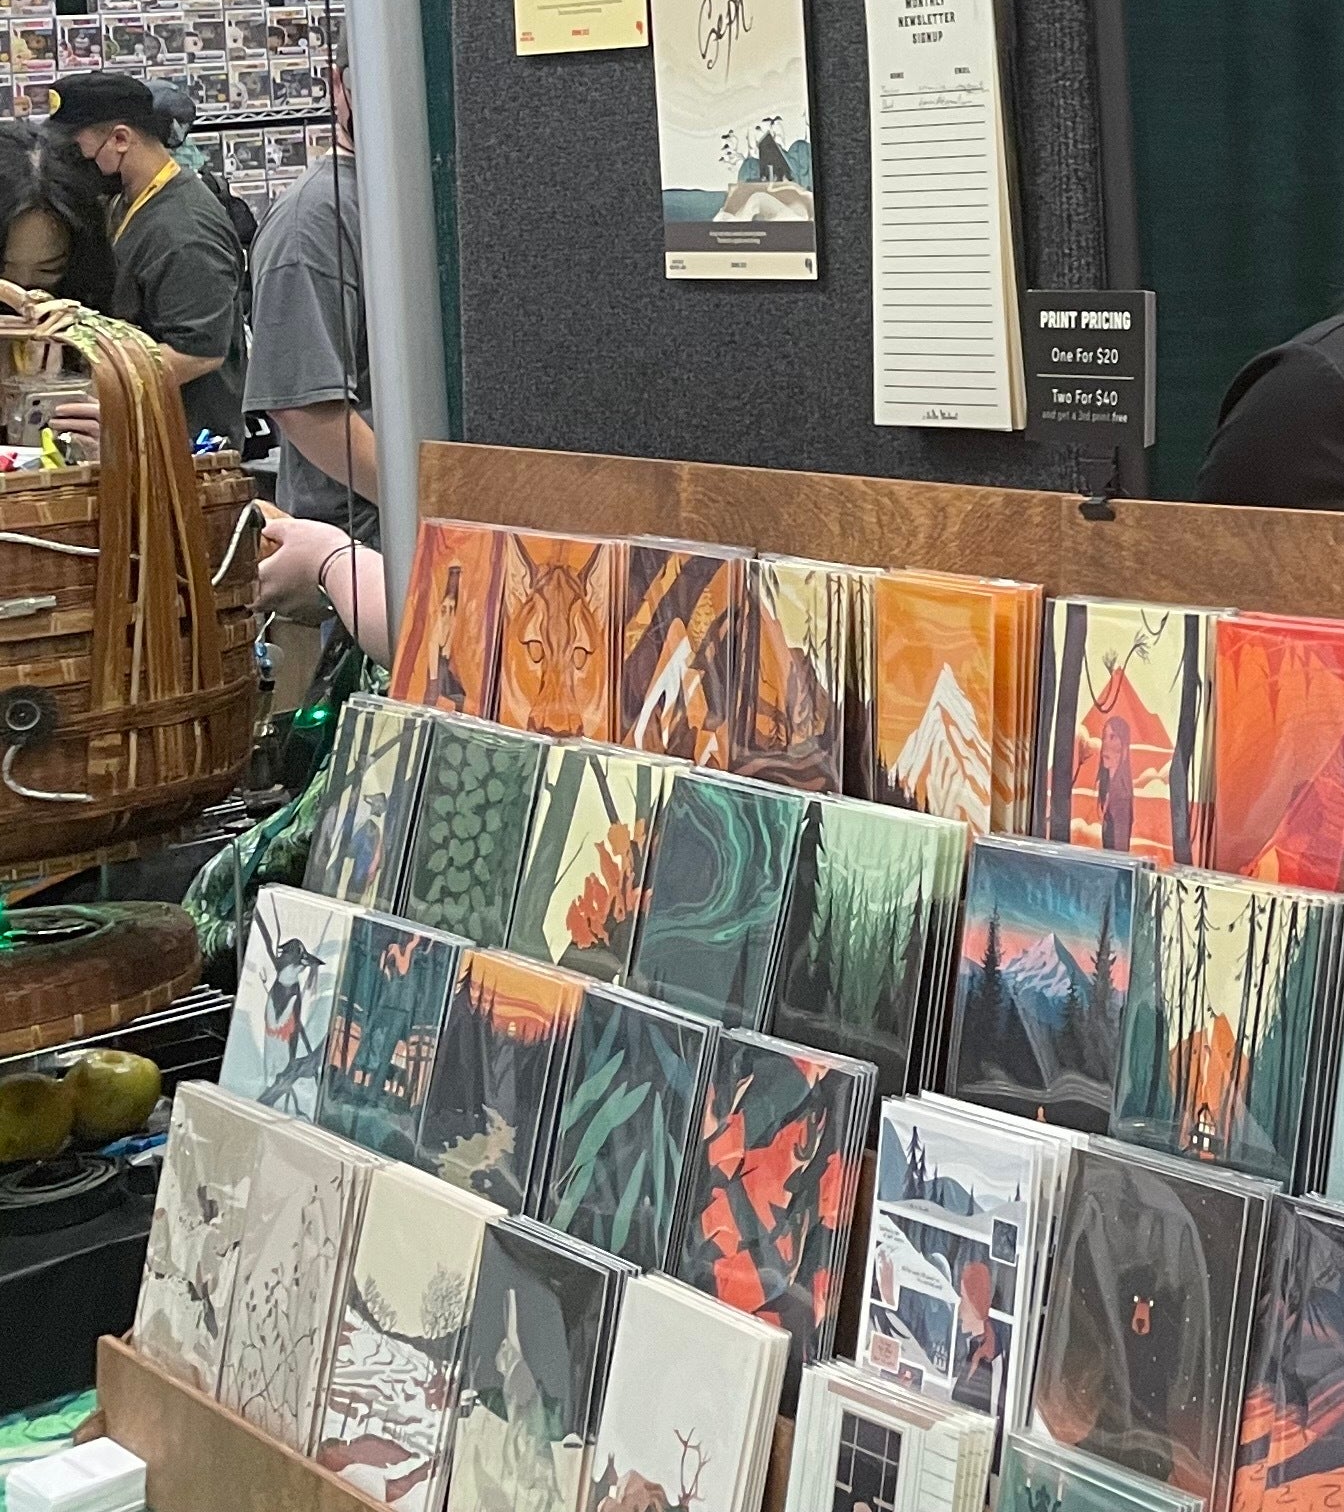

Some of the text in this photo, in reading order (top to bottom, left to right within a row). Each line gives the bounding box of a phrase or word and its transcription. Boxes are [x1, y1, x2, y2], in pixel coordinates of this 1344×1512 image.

[898, 11, 955, 28] NEWSLETTER
[1040, 310, 1131, 330] PRINT PRICING
[1051, 347, 1119, 365] One For $20
[1052, 388, 1118, 406] Two For $40
[1112, 412, 1128, 423] free
